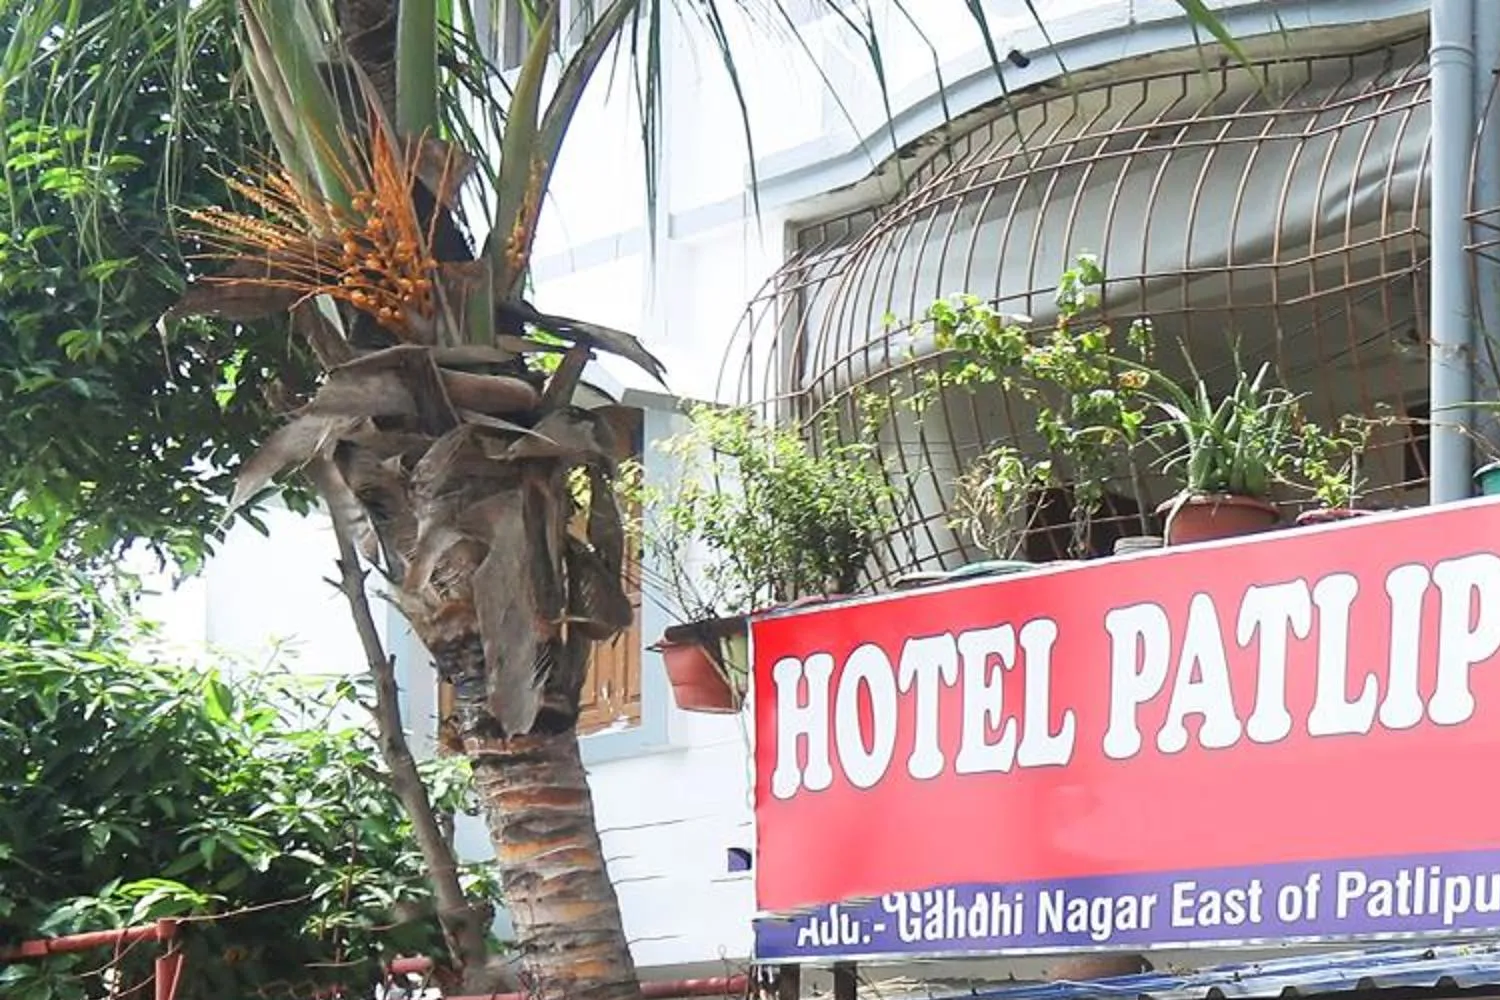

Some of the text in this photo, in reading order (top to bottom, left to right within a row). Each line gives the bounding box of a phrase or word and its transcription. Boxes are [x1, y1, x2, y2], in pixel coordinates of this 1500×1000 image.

[771, 617, 1076, 800] HOTEL
[1037, 888, 1159, 942] Nagar
[1171, 879, 1263, 928] East
[1275, 871, 1321, 923] of
